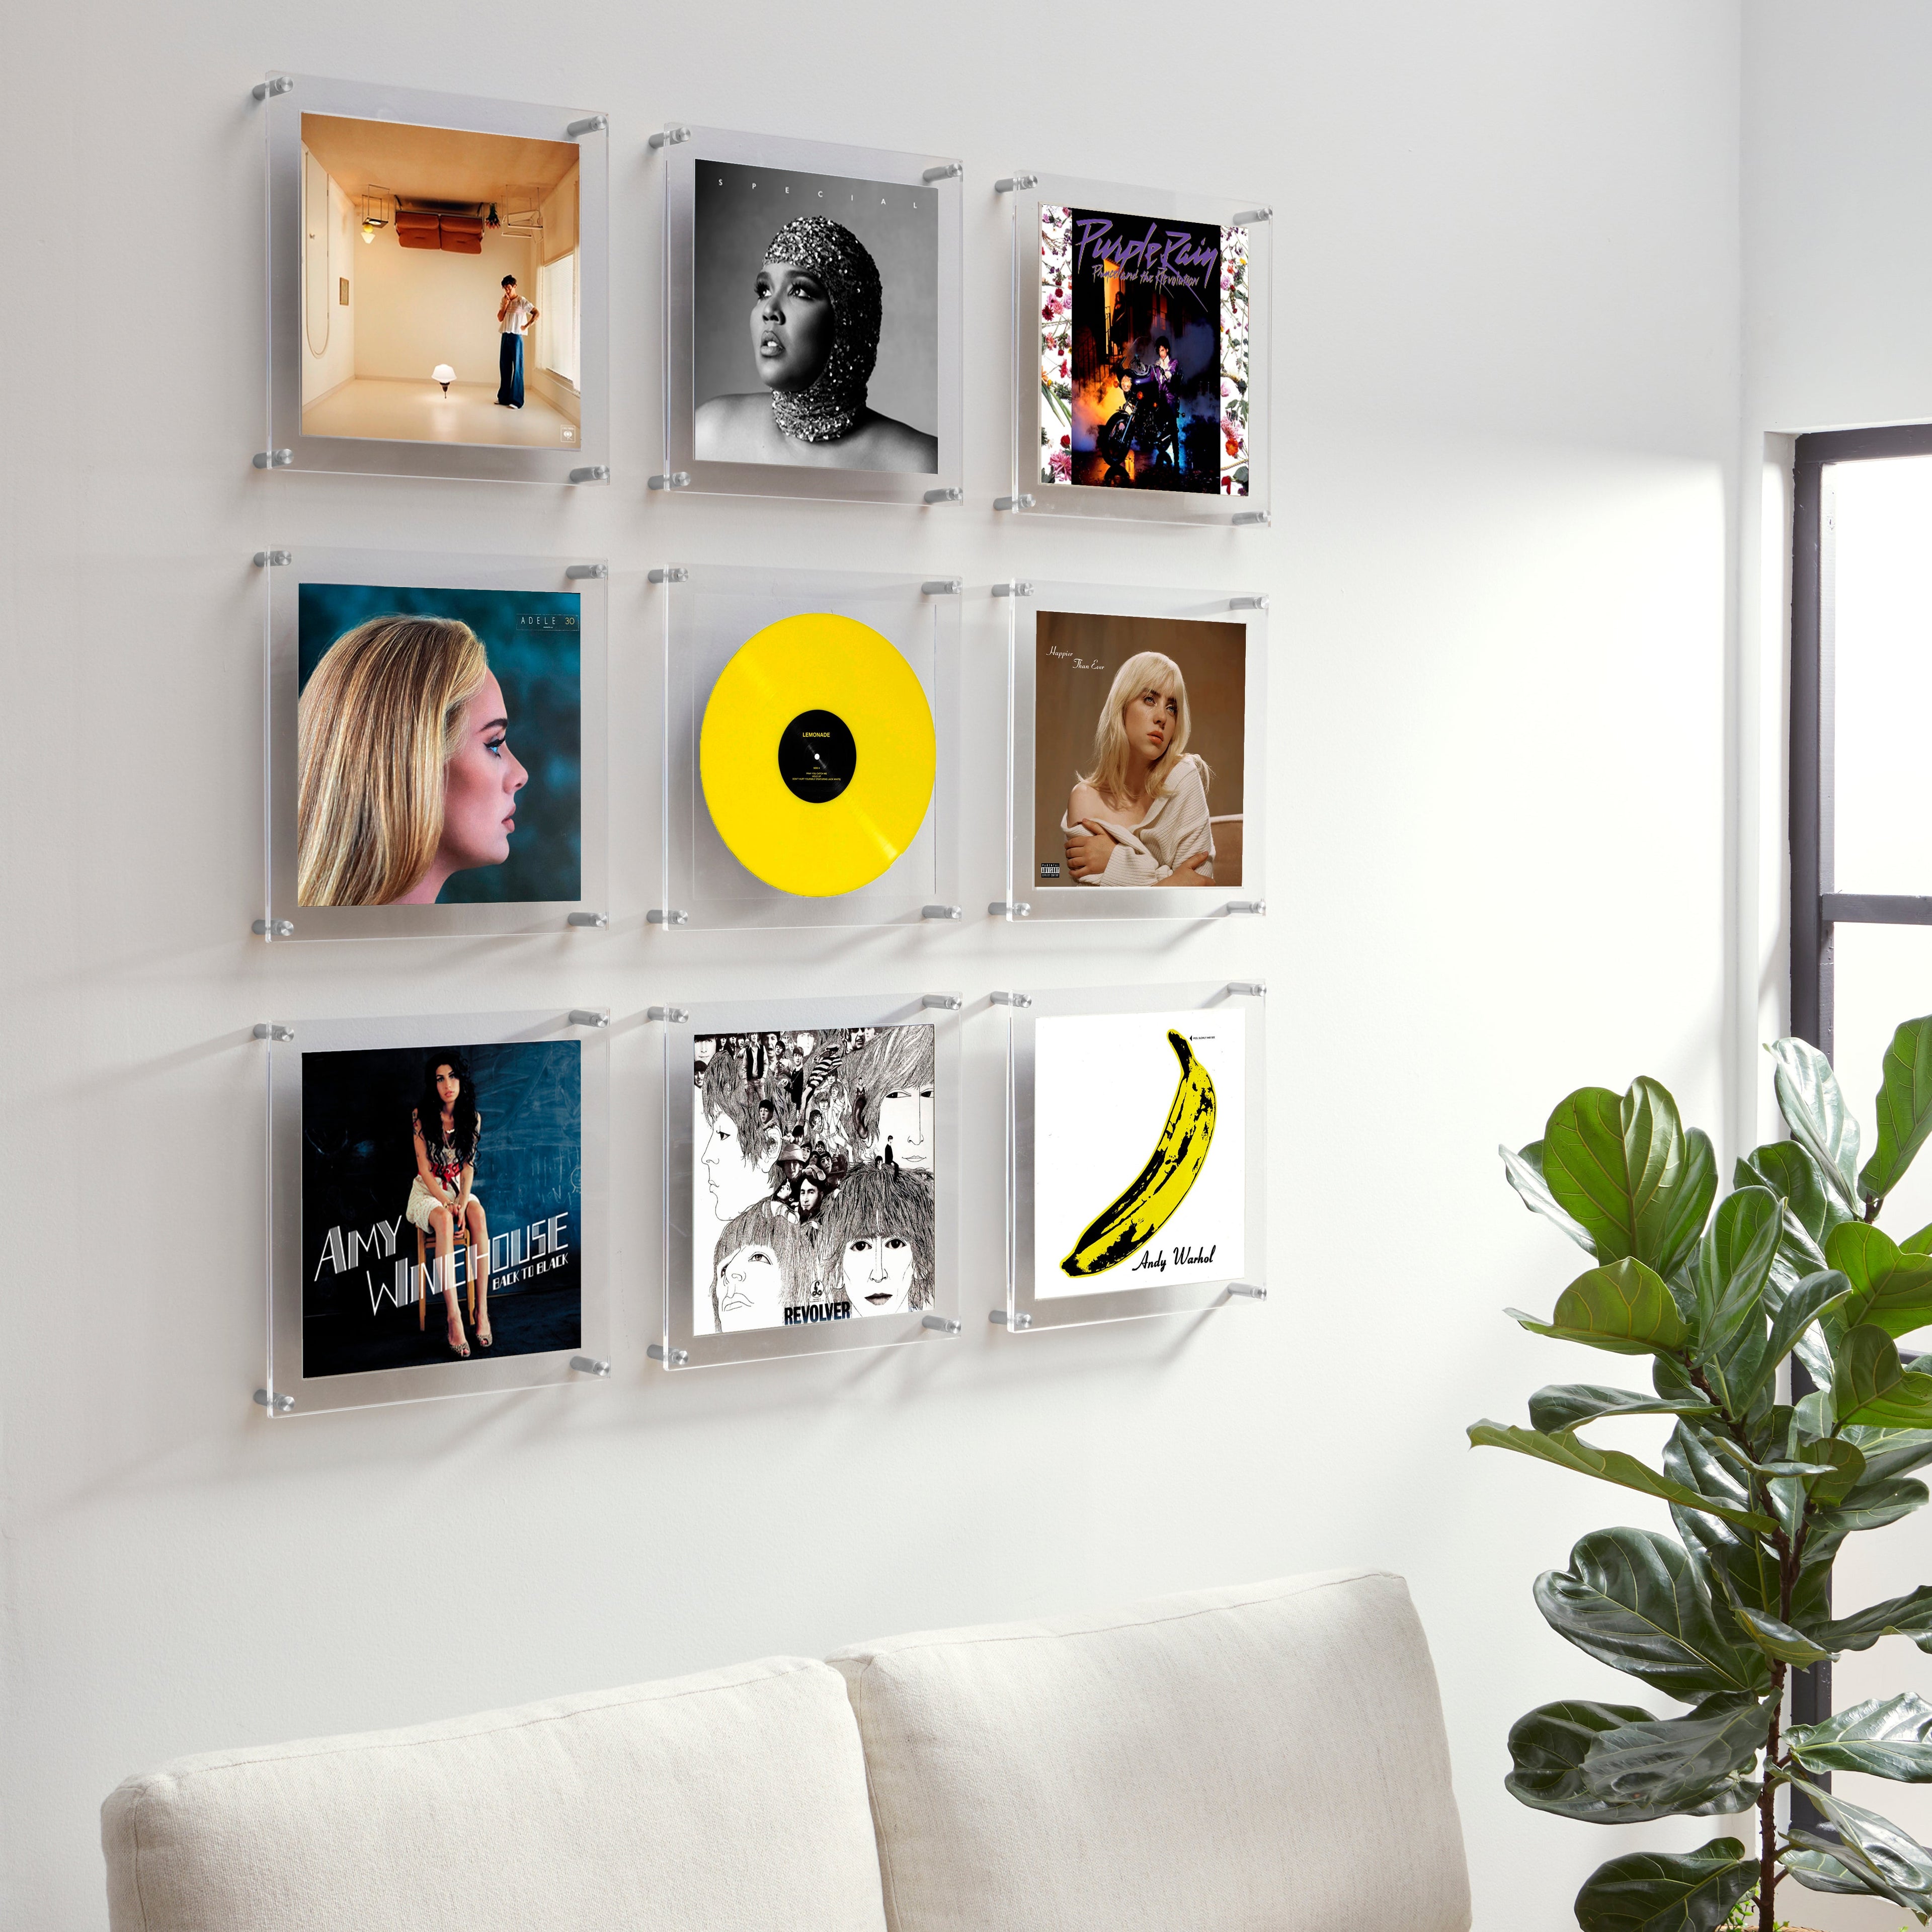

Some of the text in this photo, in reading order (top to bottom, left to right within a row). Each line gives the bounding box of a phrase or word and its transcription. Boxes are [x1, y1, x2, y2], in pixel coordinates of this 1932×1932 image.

[718, 179, 917, 209] SPECIAL
[1075, 218, 1219, 298] Purple Rain
[1091, 264, 1200, 294] Prince and the Revolution
[521, 616, 575, 625] ADELE 30
[1046, 646, 1073, 659] Happier
[1072, 658, 1105, 670] Than Ever
[314, 1215, 402, 1282] AMY
[1132, 1244, 1217, 1272] Andy Warhol
[366, 1211, 569, 1317] WINEHOUSE
[492, 1252, 569, 1291] BACK TO BLACK
[784, 1301, 851, 1326] REVOLVER
